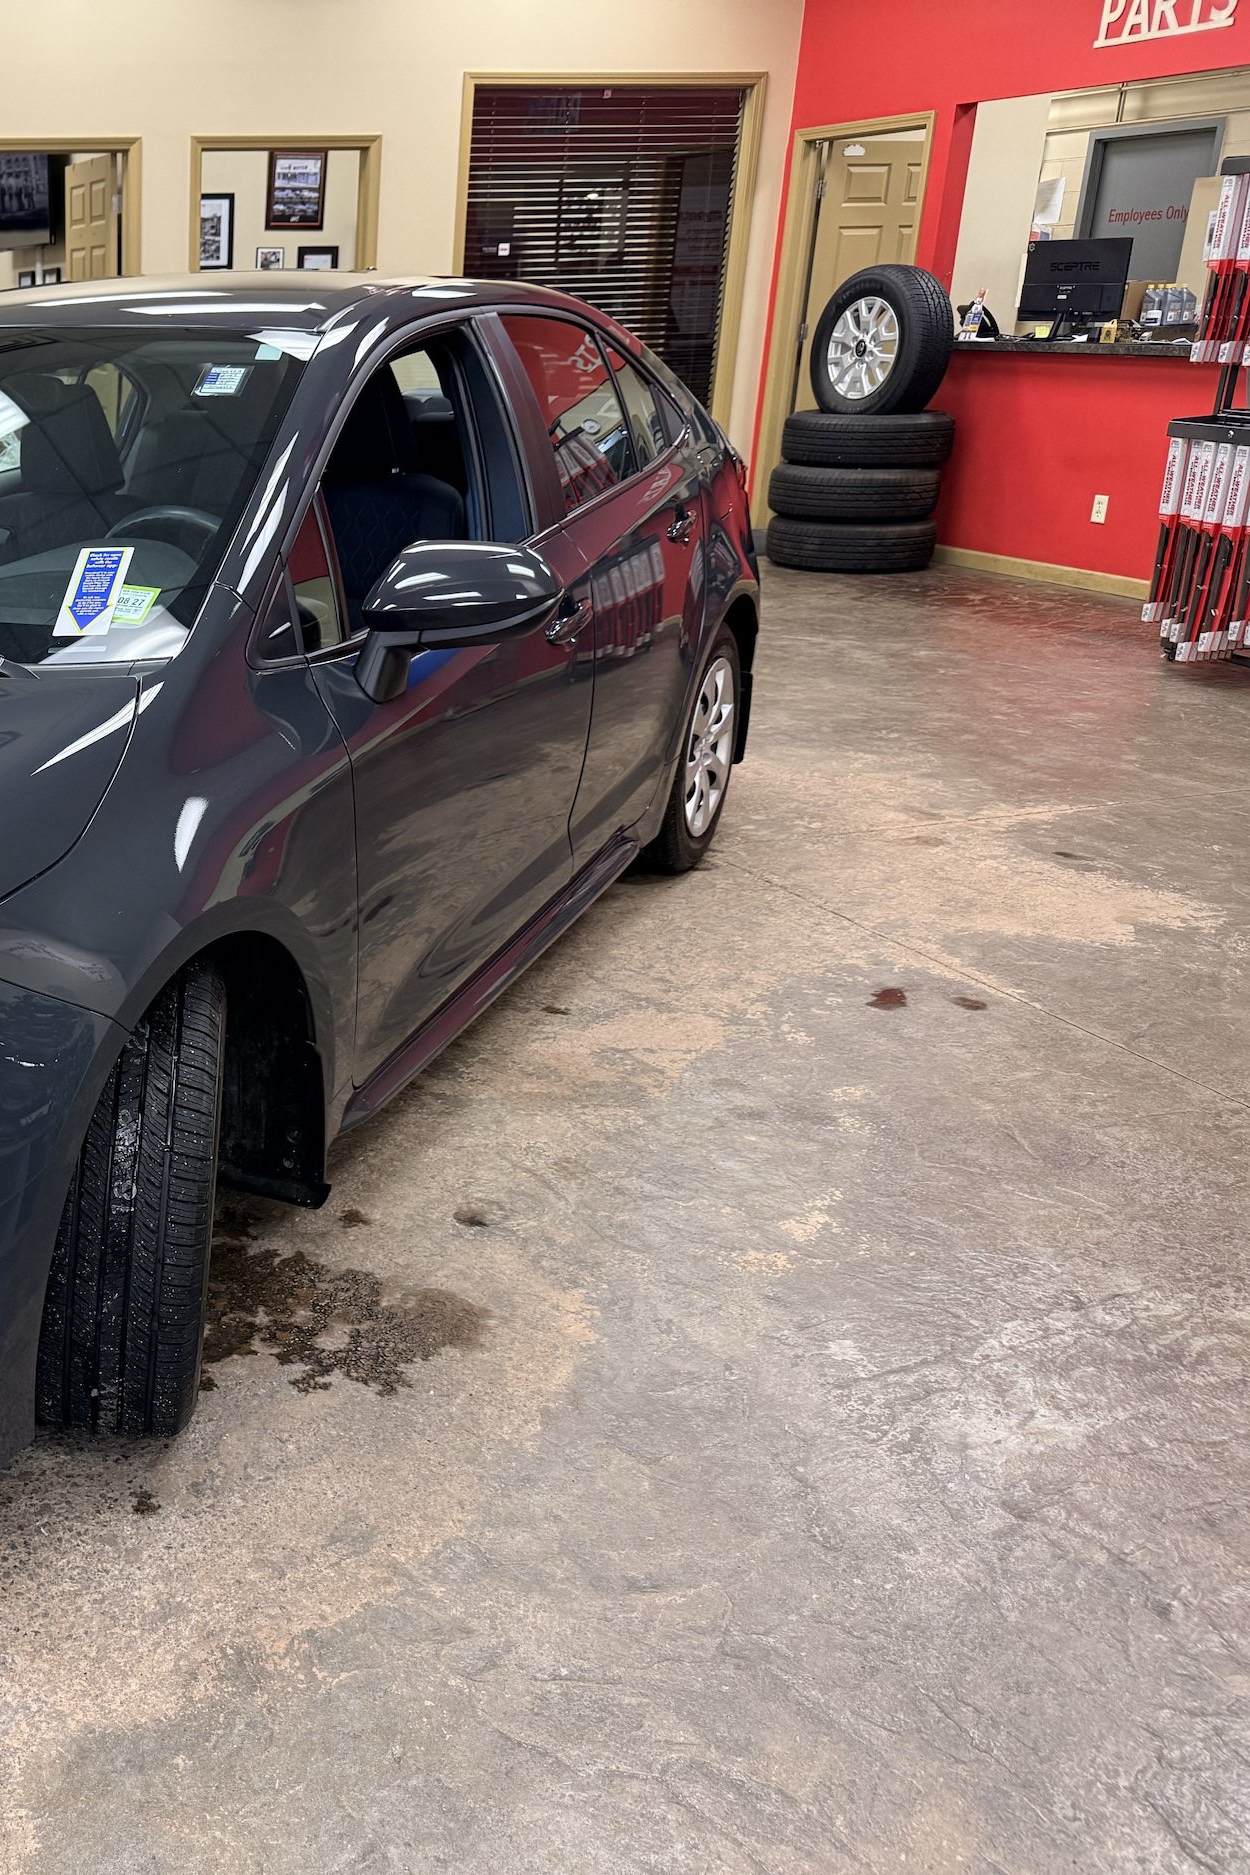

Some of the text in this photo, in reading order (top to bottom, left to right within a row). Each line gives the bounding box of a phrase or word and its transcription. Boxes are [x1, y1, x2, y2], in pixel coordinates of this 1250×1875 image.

[1109, 205, 1189, 225] Employees Only
[1050, 261, 1100, 271] SCEPTRE
[117, 596, 145, 606] 08 27
